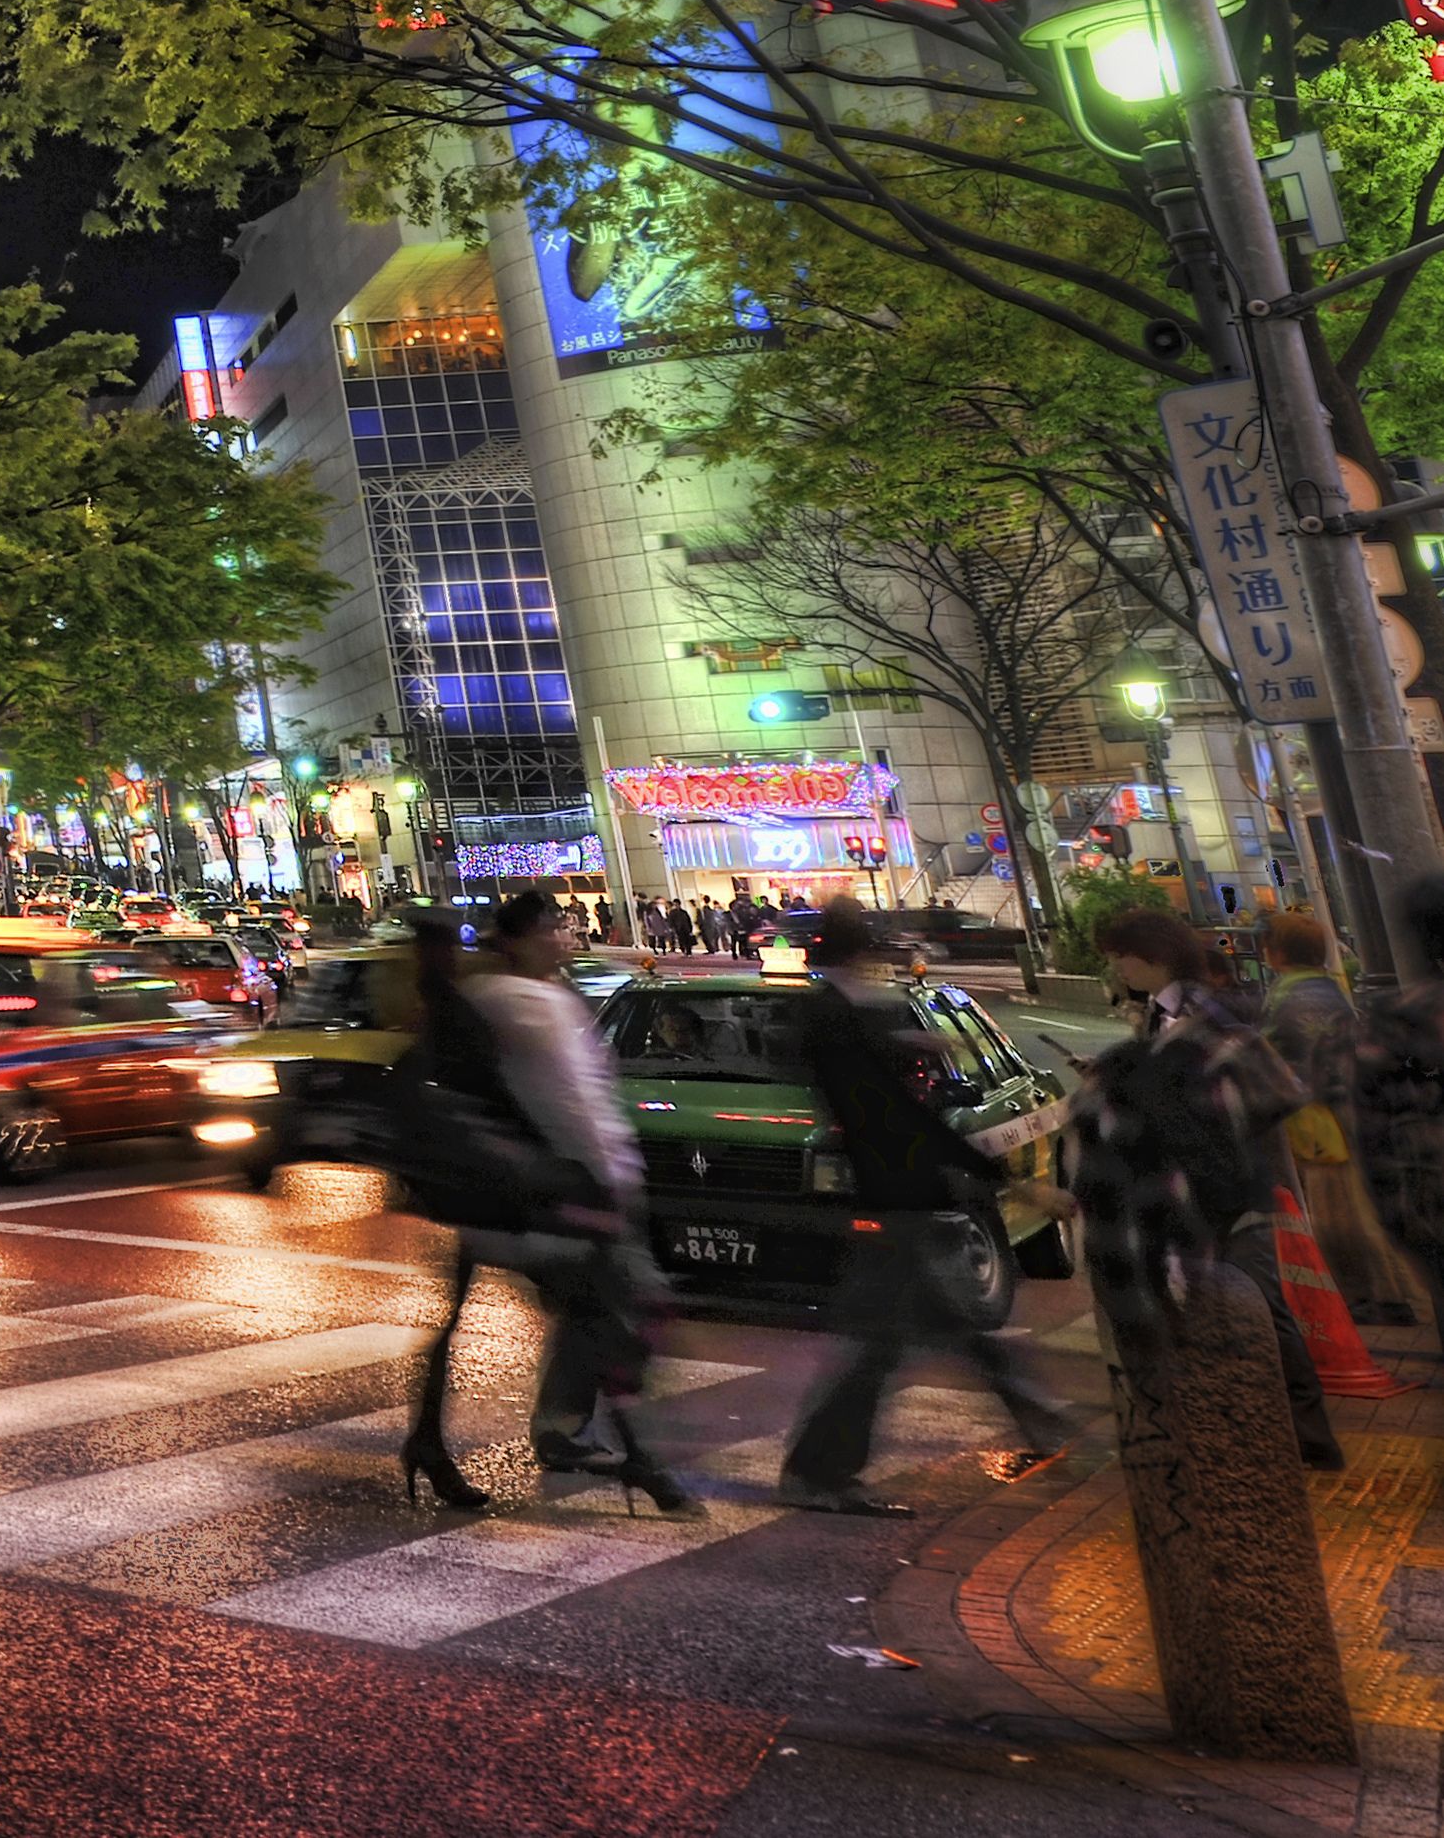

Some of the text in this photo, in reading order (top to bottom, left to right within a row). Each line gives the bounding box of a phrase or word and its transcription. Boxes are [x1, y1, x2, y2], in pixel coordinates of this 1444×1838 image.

[1185, 410, 1294, 668] 文化村通り
[1256, 675, 1318, 704] 方面
[713, 1228, 739, 1241] 500
[688, 1239, 756, 1264] 84-77
